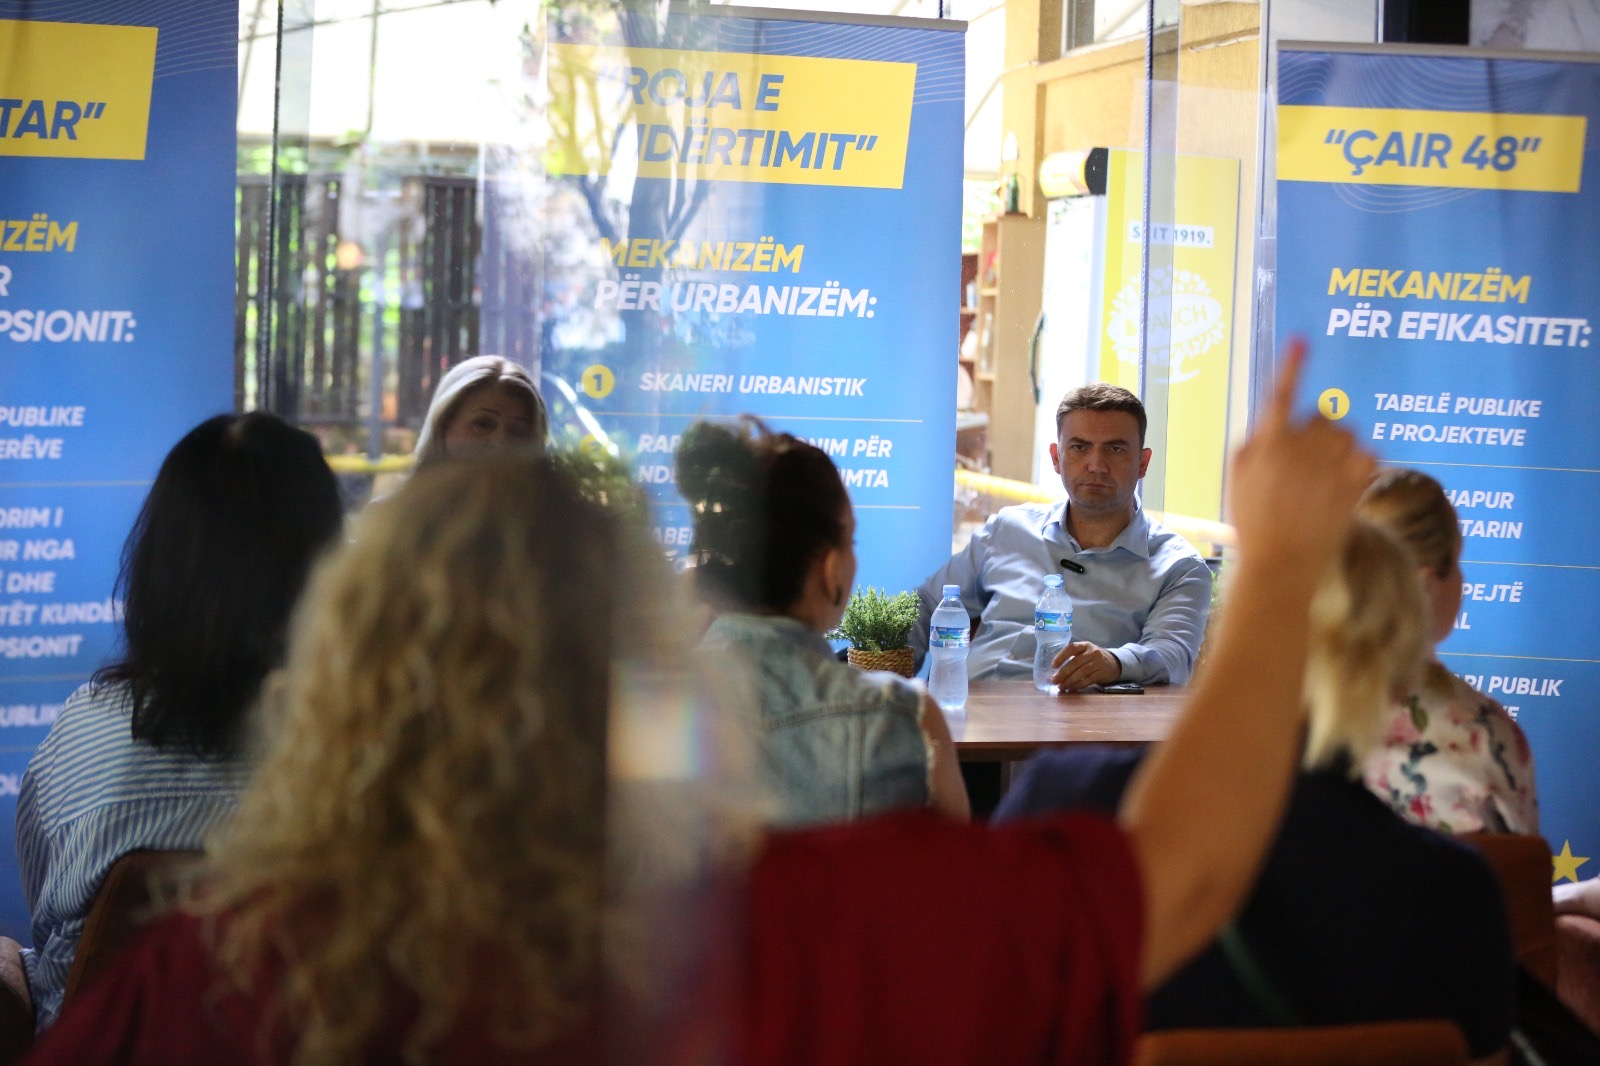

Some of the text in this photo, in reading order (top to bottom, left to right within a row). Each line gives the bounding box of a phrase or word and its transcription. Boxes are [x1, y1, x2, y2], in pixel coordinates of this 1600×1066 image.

[754, 74, 784, 112] E
[1132, 225, 1210, 245] SIT 1919.
[600, 235, 805, 274] MEKANIZËM
[593, 273, 879, 319] PËR URBANIZËM:
[1327, 266, 1532, 304] MEKANIZËM
[1147, 302, 1208, 333] AUCH
[1325, 302, 1593, 349] PËR EFIKASITET:
[639, 372, 734, 393] SKANERI
[739, 375, 867, 398] URBANISTIK
[1329, 392, 1542, 418] 1 TABELË PUBLIKE
[638, 434, 682, 453] RAP
[852, 434, 893, 458] PËR
[1372, 423, 1527, 447] E PROJEKTEVE
[23, 539, 75, 561] NGA
[6, 571, 55, 593] DHE
[1488, 676, 1564, 697] PUBLIK
